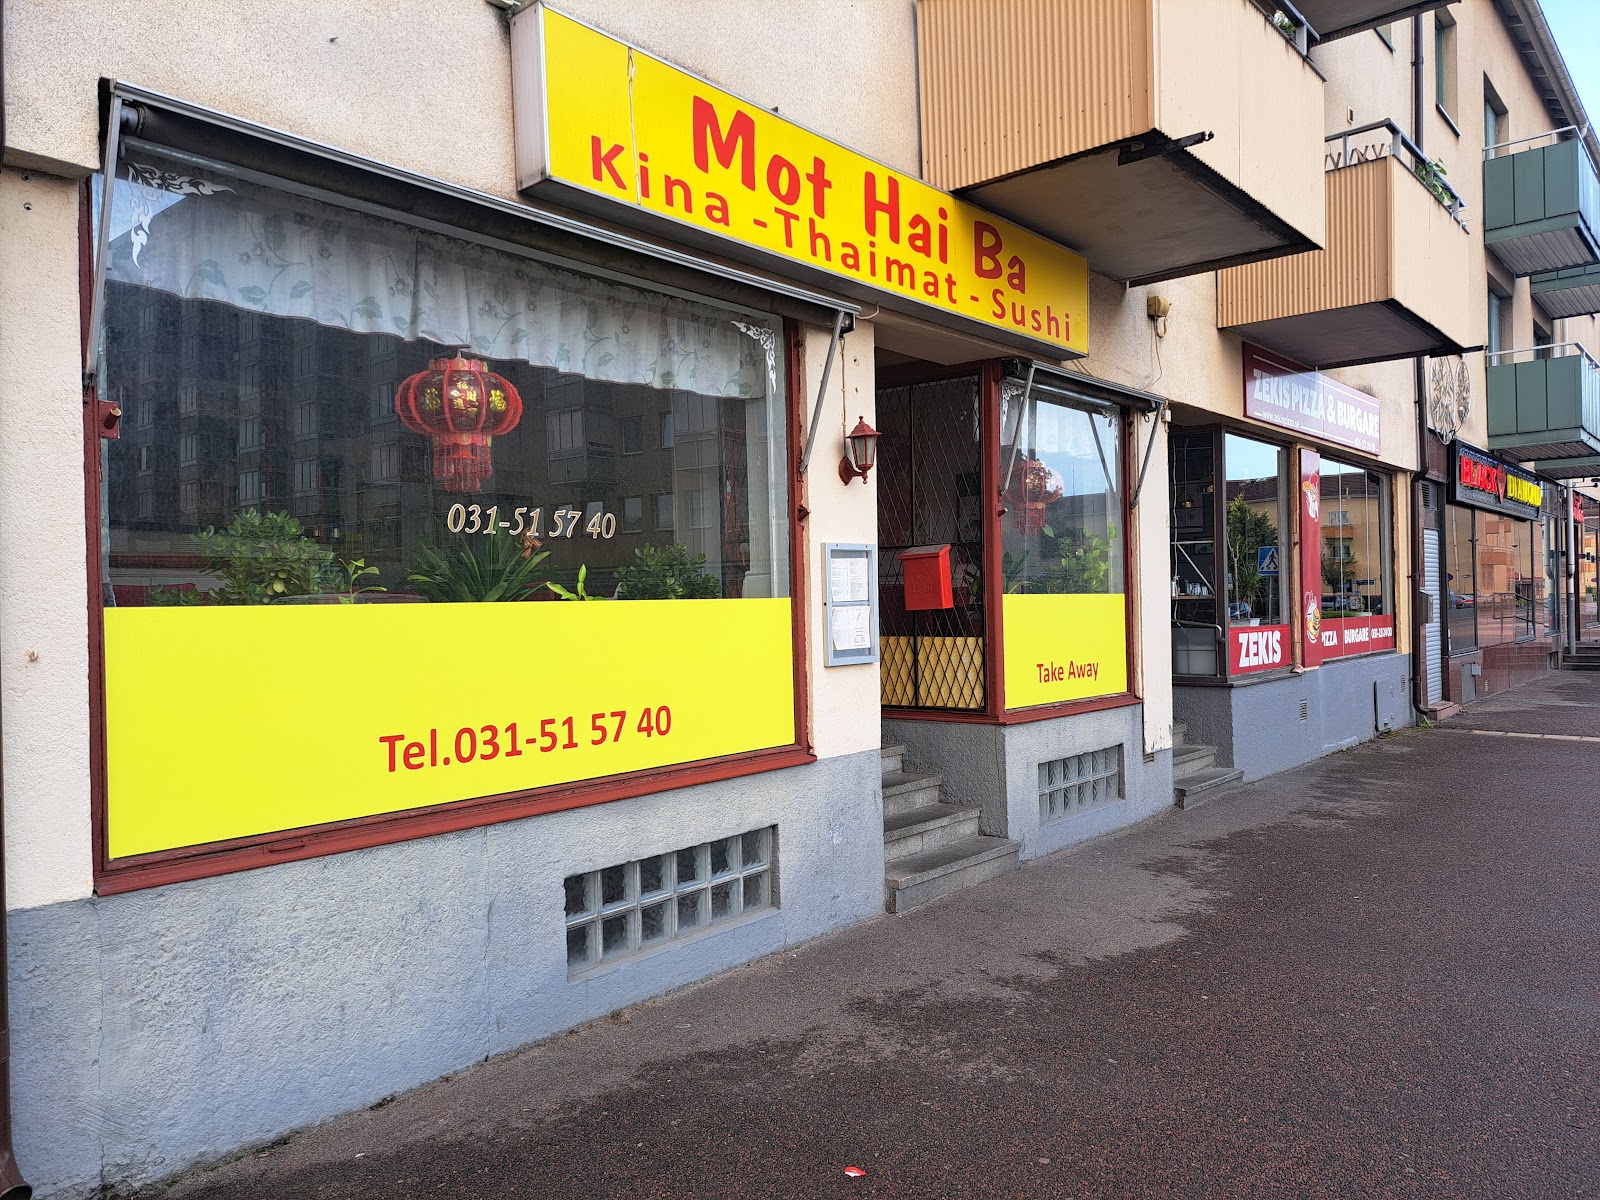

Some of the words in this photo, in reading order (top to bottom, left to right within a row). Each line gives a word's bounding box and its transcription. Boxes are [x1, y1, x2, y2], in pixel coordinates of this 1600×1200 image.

[693, 96, 832, 219] Mot
[864, 171, 948, 265] Hai
[974, 220, 1026, 294] Ba
[591, 136, 729, 227] Kina
[991, 288, 1070, 342] Sushi
[1253, 368, 1290, 410] ZEKIS
[1291, 383, 1325, 421] PIZZA
[1327, 394, 1337, 425] &
[1337, 399, 1379, 439] BURGARE
[1460, 455, 1498, 494] BLACK
[1506, 473, 1542, 508] DIAMOND
[447, 503, 541, 537] 031-51
[549, 509, 582, 538] 57
[586, 512, 617, 539] 40
[1238, 630, 1281, 668] ZEKIS
[1344, 627, 1369, 645] BURGARE
[1036, 661, 1064, 683] Take
[1067, 660, 1099, 681] Away
[591, 711, 627, 746] 57
[637, 705, 672, 738] 40
